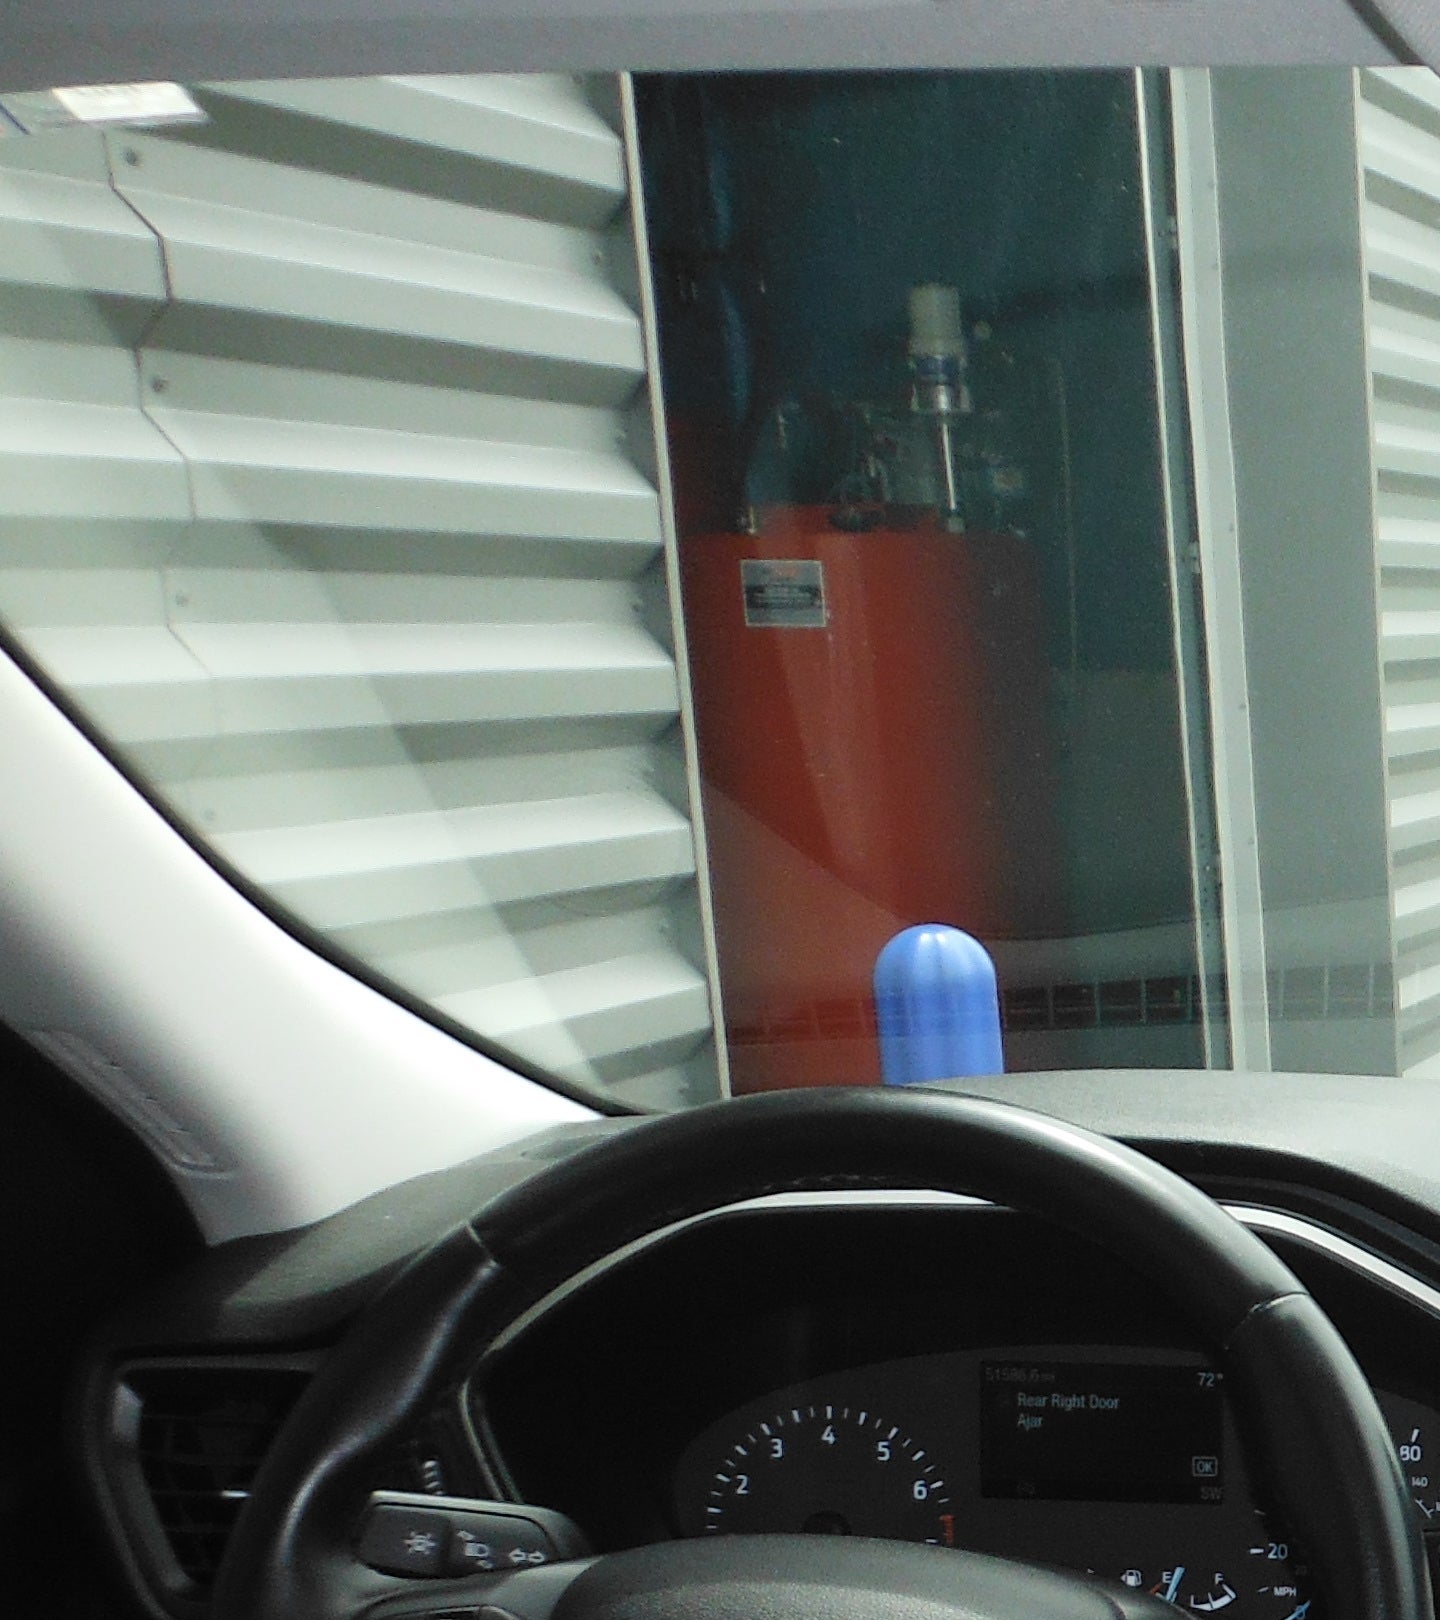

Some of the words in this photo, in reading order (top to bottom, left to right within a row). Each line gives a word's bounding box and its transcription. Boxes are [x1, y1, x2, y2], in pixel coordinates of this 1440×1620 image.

[1017, 1392, 1047, 1407] Rear
[1051, 1392, 1086, 1412] Right
[1089, 1394, 1121, 1409] Door
[1017, 1413, 1043, 1430] Ajar
[821, 1424, 837, 1445] 4
[770, 1438, 784, 1459] 3
[876, 1441, 891, 1462] 5
[735, 1474, 751, 1495] 2
[912, 1480, 928, 1501] 6
[1267, 1543, 1288, 1560] 20
[1162, 1571, 1173, 1583] E
[1214, 1573, 1225, 1584] F
[1273, 1586, 1297, 1598] MPH
